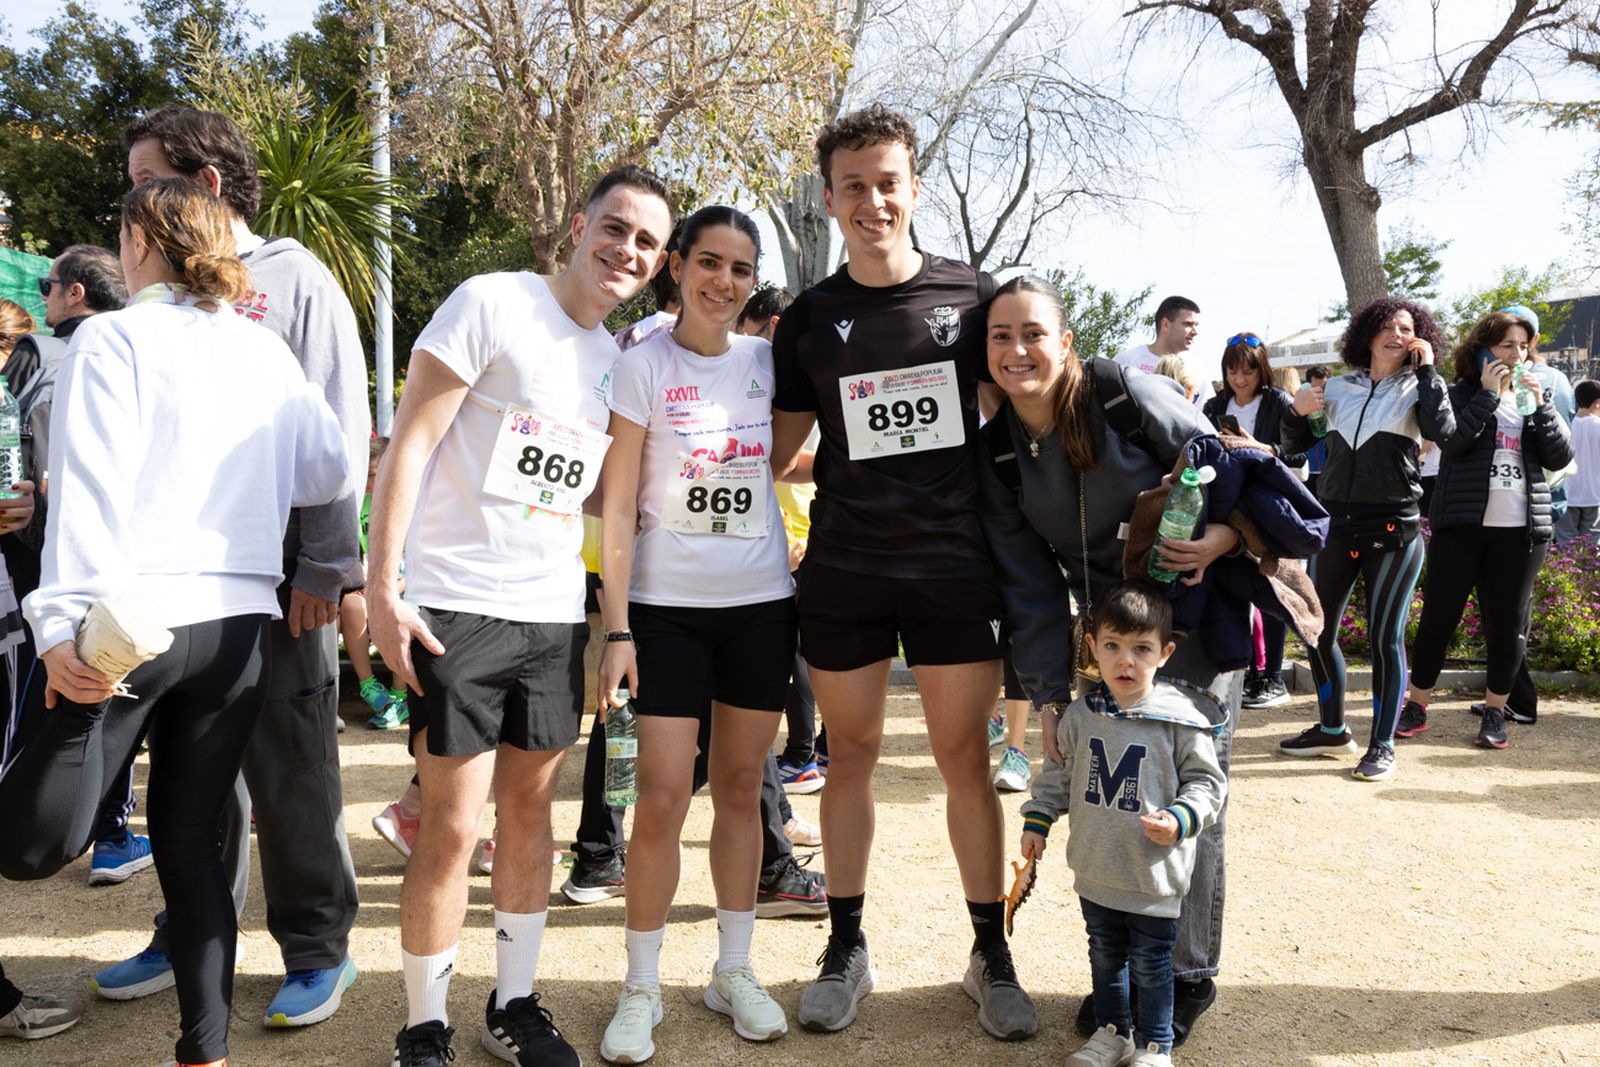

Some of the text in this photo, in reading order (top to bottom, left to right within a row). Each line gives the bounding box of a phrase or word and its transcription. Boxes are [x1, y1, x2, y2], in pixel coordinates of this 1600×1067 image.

[665, 386, 701, 402] XXVII
[868, 397, 939, 431] 899
[517, 446, 585, 489] 868
[1489, 464, 1522, 480] 833
[686, 486, 752, 514] 869
[1084, 736, 1148, 814] M
[1088, 755, 1100, 793] MASTER
[1125, 776, 1137, 801] 1965
